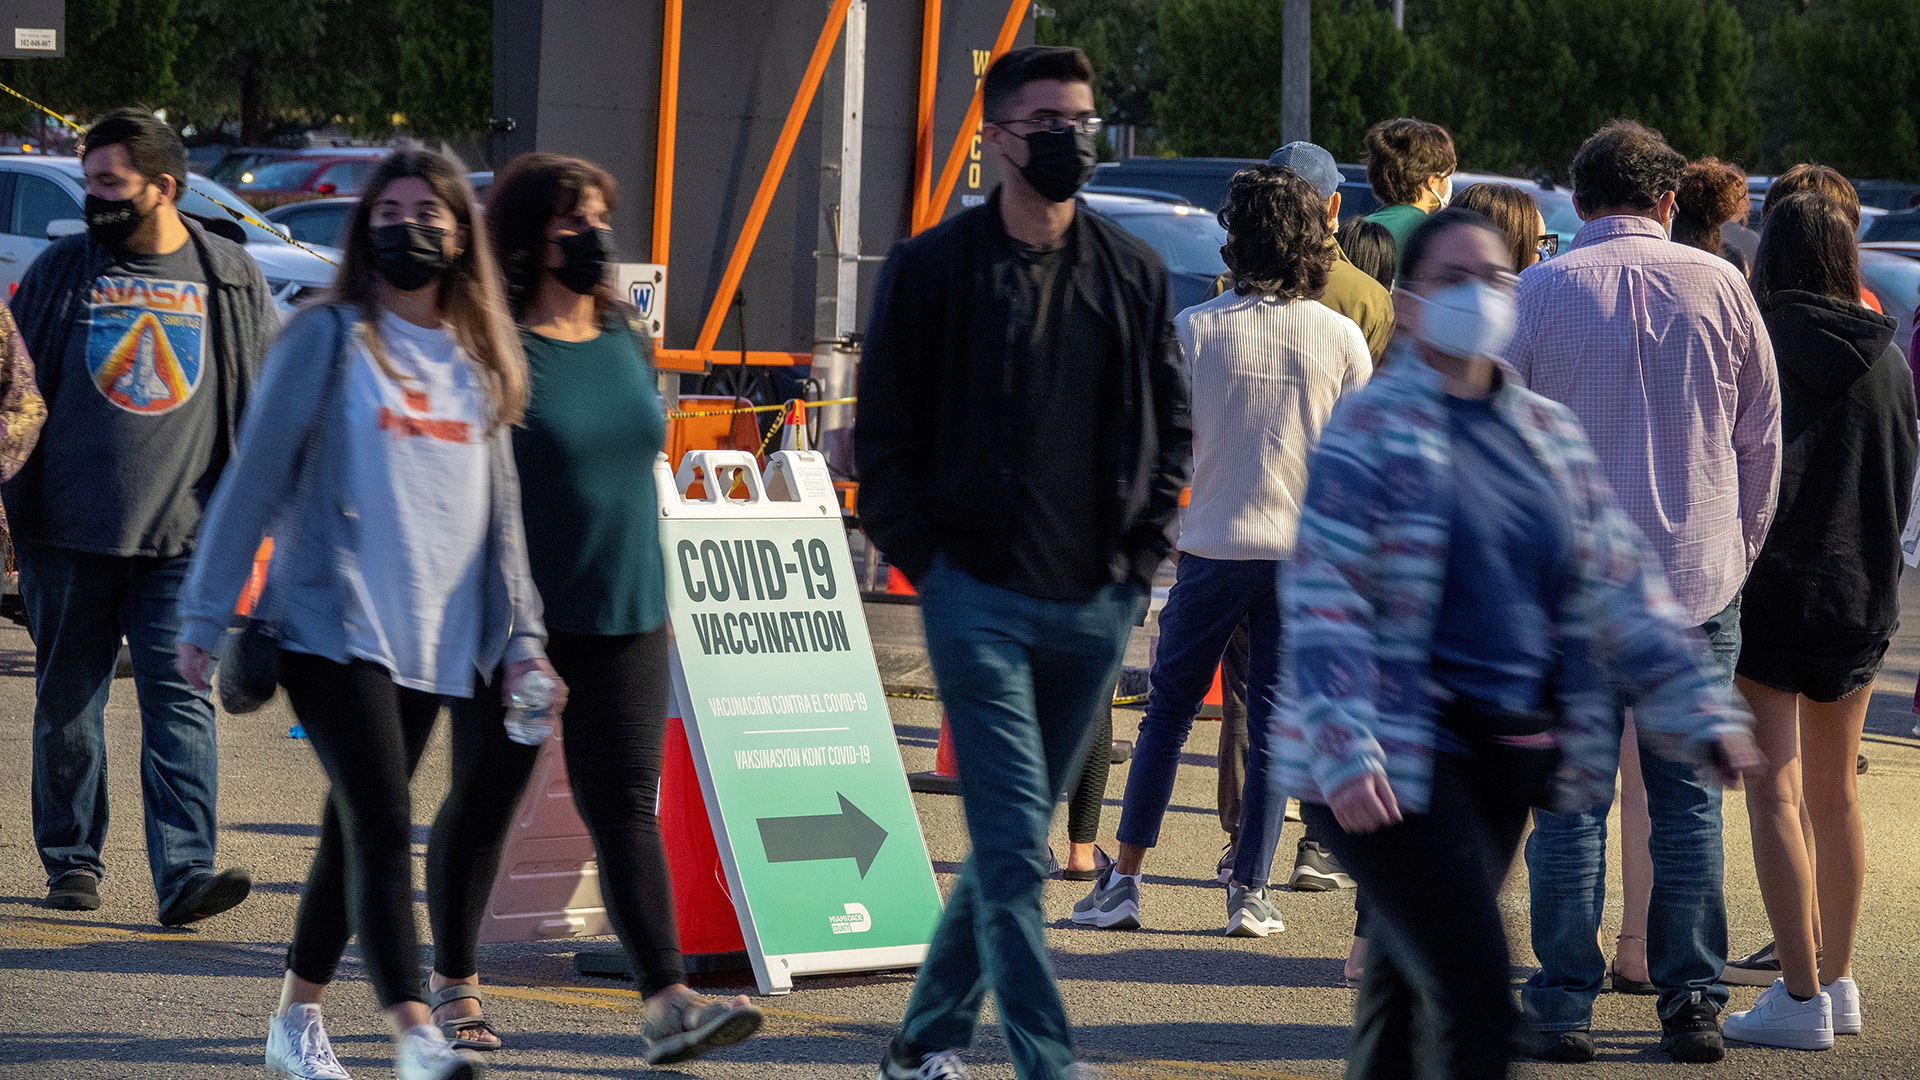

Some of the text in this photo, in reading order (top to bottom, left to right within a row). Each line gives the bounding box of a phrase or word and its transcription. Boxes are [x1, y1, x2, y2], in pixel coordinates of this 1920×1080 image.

[93, 276, 203, 313] NASA
[677, 538, 837, 602] COVID-19
[691, 610, 851, 655] VACCINATION
[708, 692, 868, 717] VACUNACIÓN CONTRA EL COVID-19
[734, 745, 871, 770] VAKSINASYON KONT COVID-19
